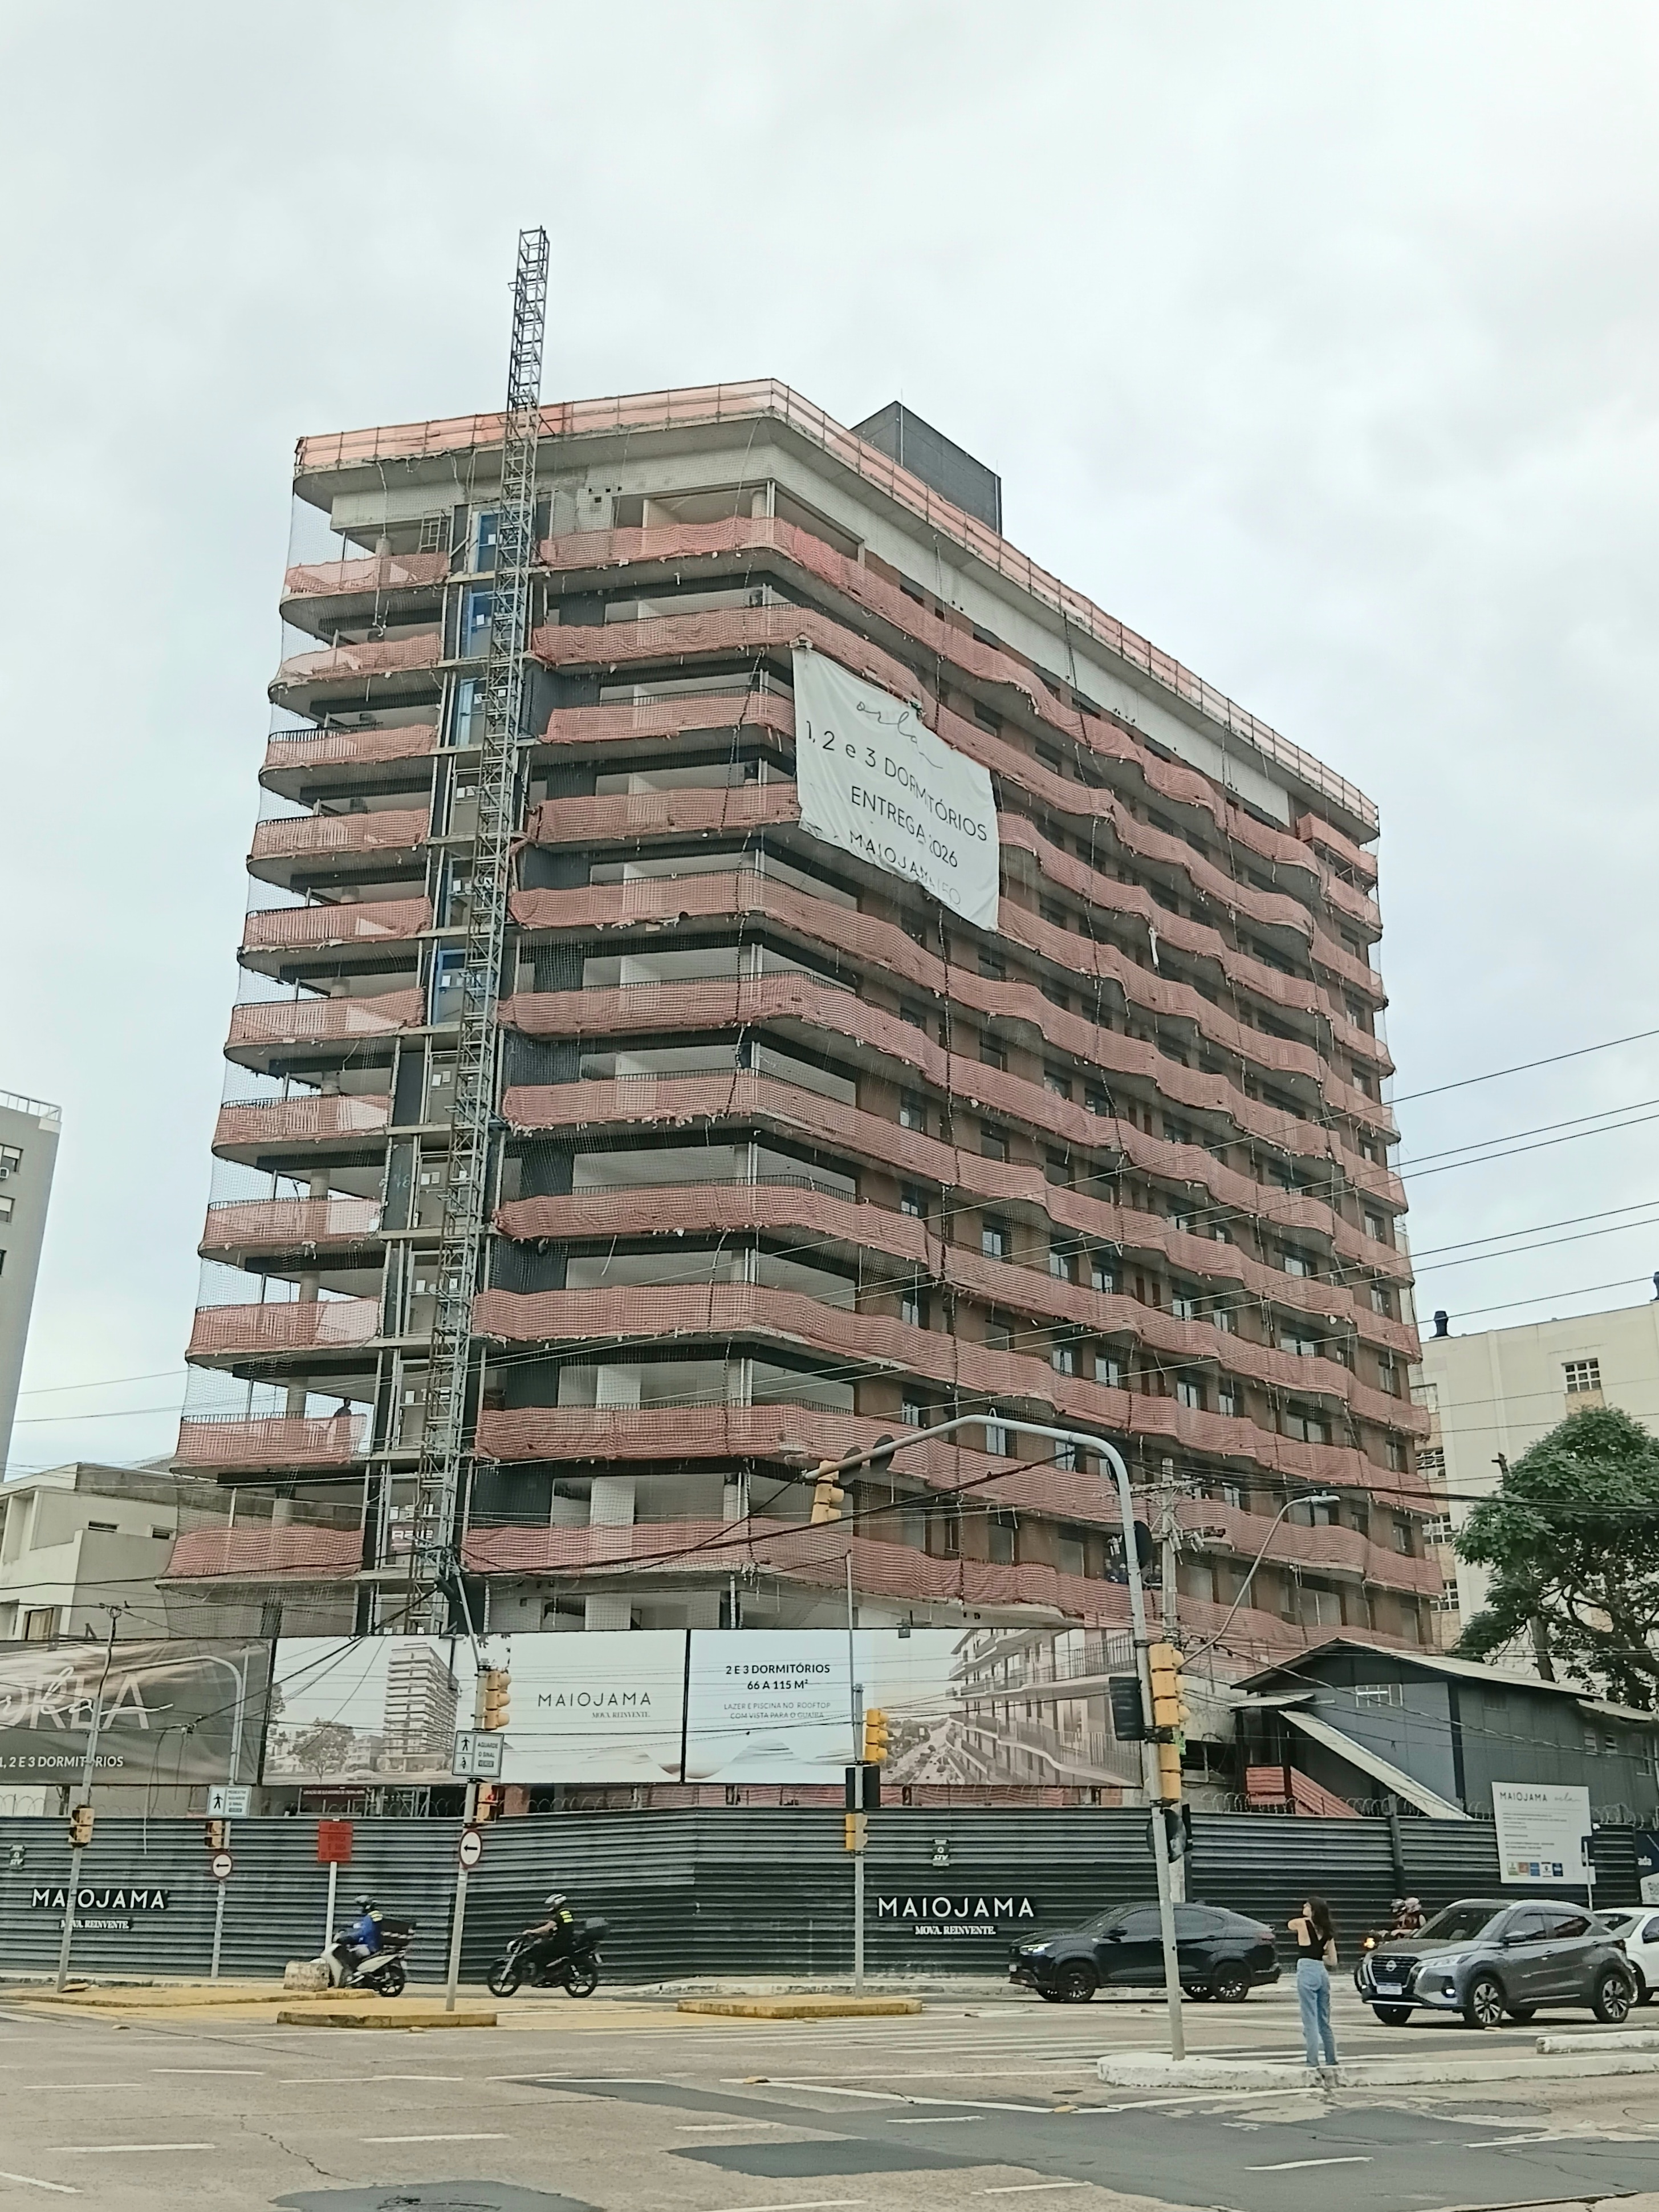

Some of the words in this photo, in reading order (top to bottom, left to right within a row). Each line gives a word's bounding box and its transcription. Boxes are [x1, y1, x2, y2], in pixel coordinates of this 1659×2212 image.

[822, 730, 835, 751] 2
[845, 744, 856, 758] e
[865, 747, 876, 768] 3
[851, 785, 926, 843] ENTREGA
[726, 1666, 732, 1674] 2
[734, 1666, 741, 1674] E
[743, 1665, 749, 1674] 3
[752, 1662, 830, 1674] DORMITÓRIOS
[747, 1681, 760, 1690] 66
[762, 1681, 770, 1690] A
[774, 1681, 791, 1689] 115
[538, 1692, 651, 1707] MAIOJAMA
[9, 1756, 16, 1767] 2
[18, 1756, 26, 1767] E
[28, 1756, 35, 1767] 3
[38, 1756, 124, 1767] DORMITRIOS
[1500, 1792, 1548, 1802] MAIOJAMA
[32, 1888, 165, 1909] MAOJAMA
[879, 1897, 1035, 1918] MAIOJAMA
[915, 1925, 942, 1935] MOVA.
[944, 1925, 997, 1935] REINVENTE.
